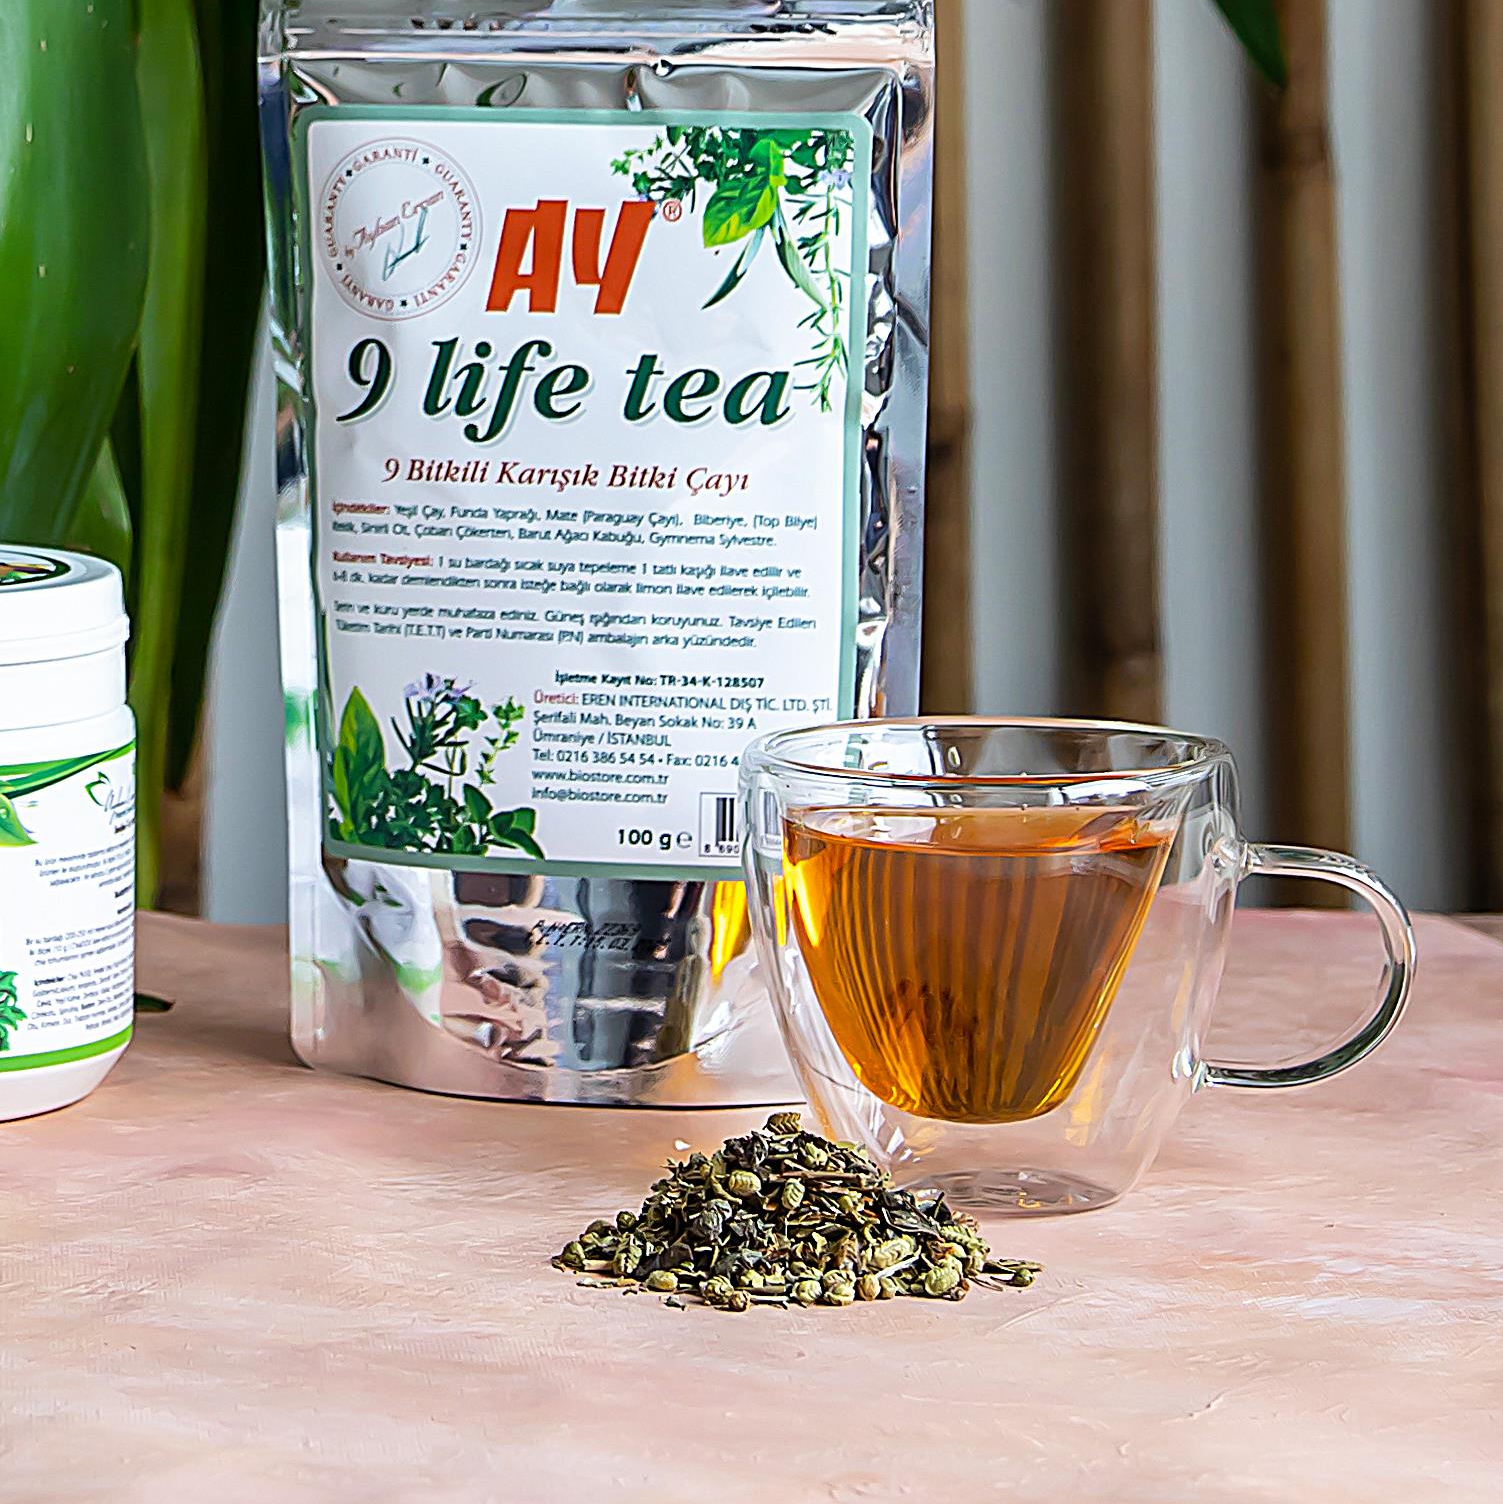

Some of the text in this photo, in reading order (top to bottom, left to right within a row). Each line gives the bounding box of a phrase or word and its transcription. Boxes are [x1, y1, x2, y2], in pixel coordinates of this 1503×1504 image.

[485, 199, 656, 316] AY
[336, 337, 794, 444] 9 life tea
[383, 458, 749, 498] 9 Bitkili Karışık Bitki Çayı
[545, 509, 578, 522] Mate
[448, 557, 462, 569] su
[548, 560, 576, 575] suya
[787, 568, 801, 578] ve
[636, 582, 672, 594] limon
[729, 615, 773, 631] Tavsiye
[448, 627, 463, 638] ve
[635, 673, 657, 686] No:
[582, 693, 616, 707] EREN
[619, 694, 727, 711] INTERNATIONAL
[783, 698, 810, 712] LTD.
[615, 713, 656, 729] Beyan
[659, 714, 698, 728] Sokak
[702, 716, 725, 729] No:
[727, 716, 744, 729] 39
[747, 717, 757, 730] A
[607, 730, 672, 747] İSTANBUL
[532, 748, 554, 762] Tel:
[557, 750, 589, 764] 0216
[619, 752, 636, 765] 54
[639, 753, 656, 765] 54
[695, 755, 728, 767] 0216
[618, 829, 653, 846] 100
